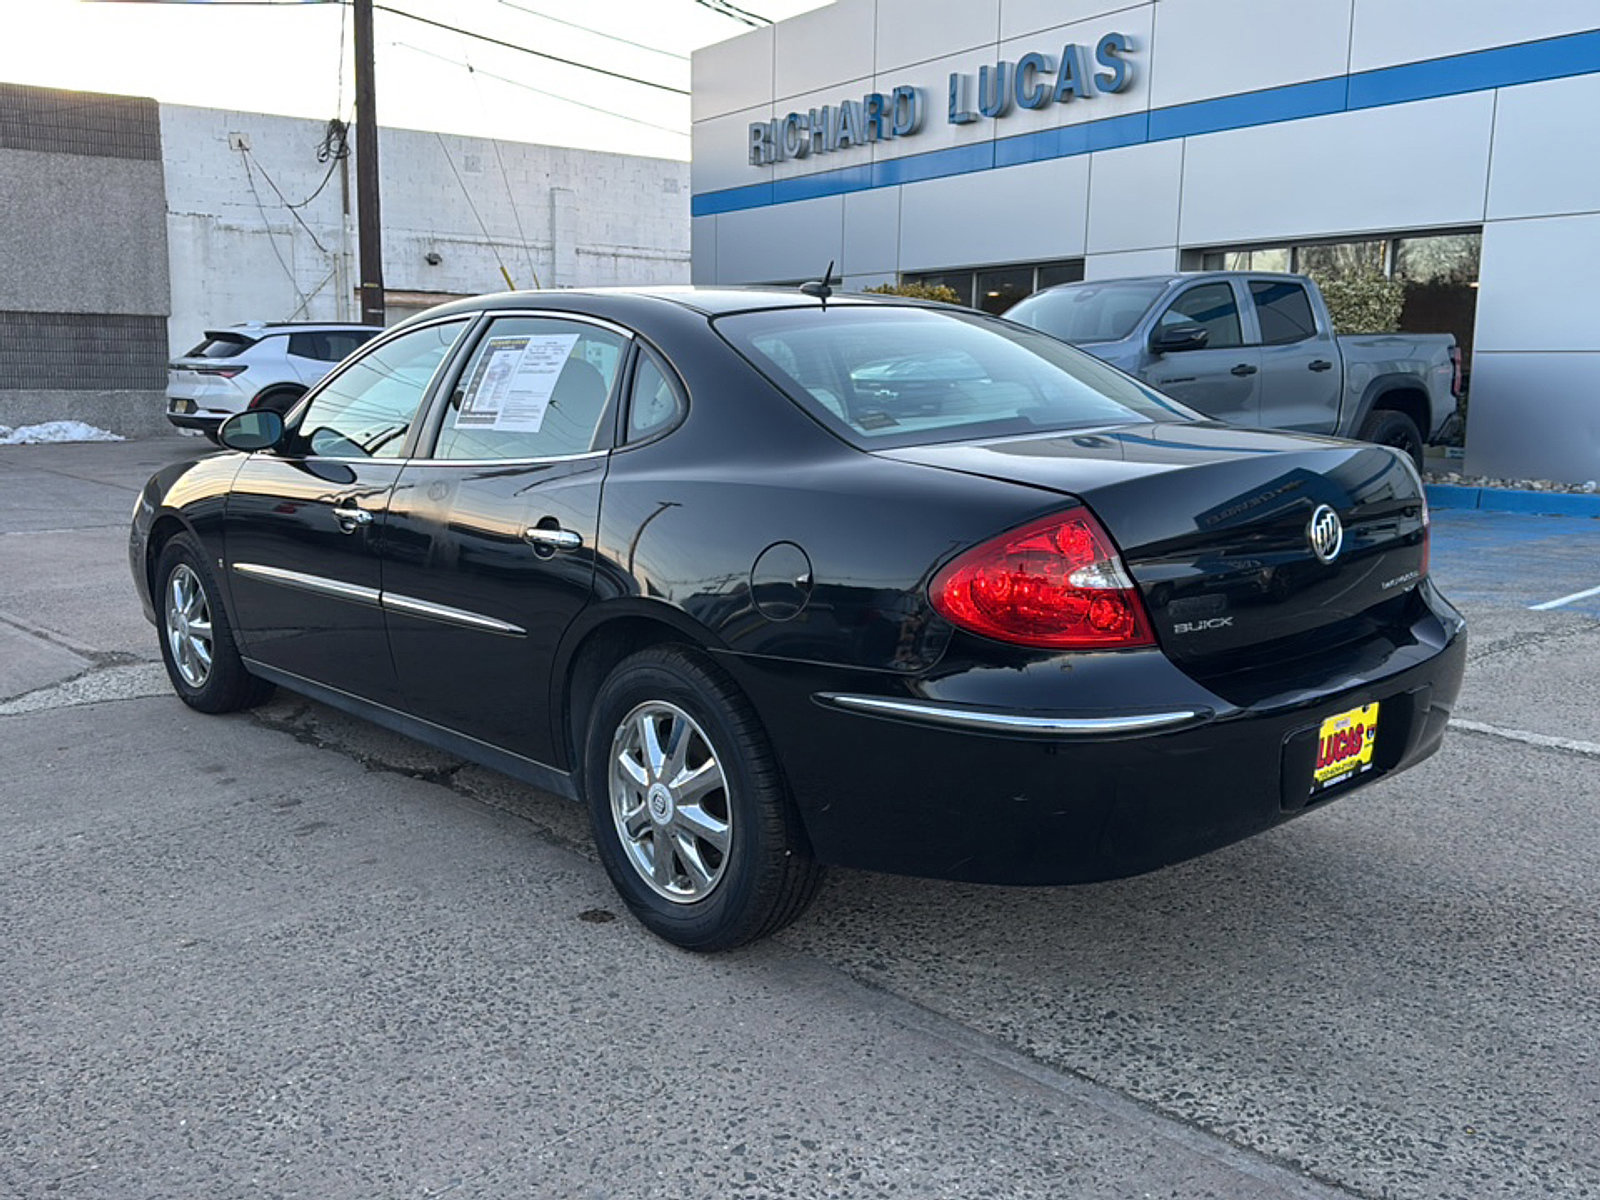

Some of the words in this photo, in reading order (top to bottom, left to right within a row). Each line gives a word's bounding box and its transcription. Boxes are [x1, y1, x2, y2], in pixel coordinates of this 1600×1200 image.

[749, 85, 919, 165] RICHARD
[949, 32, 1129, 124] LUCAS
[1174, 616, 1233, 634] BUICK
[1317, 723, 1364, 768] LUCAS
